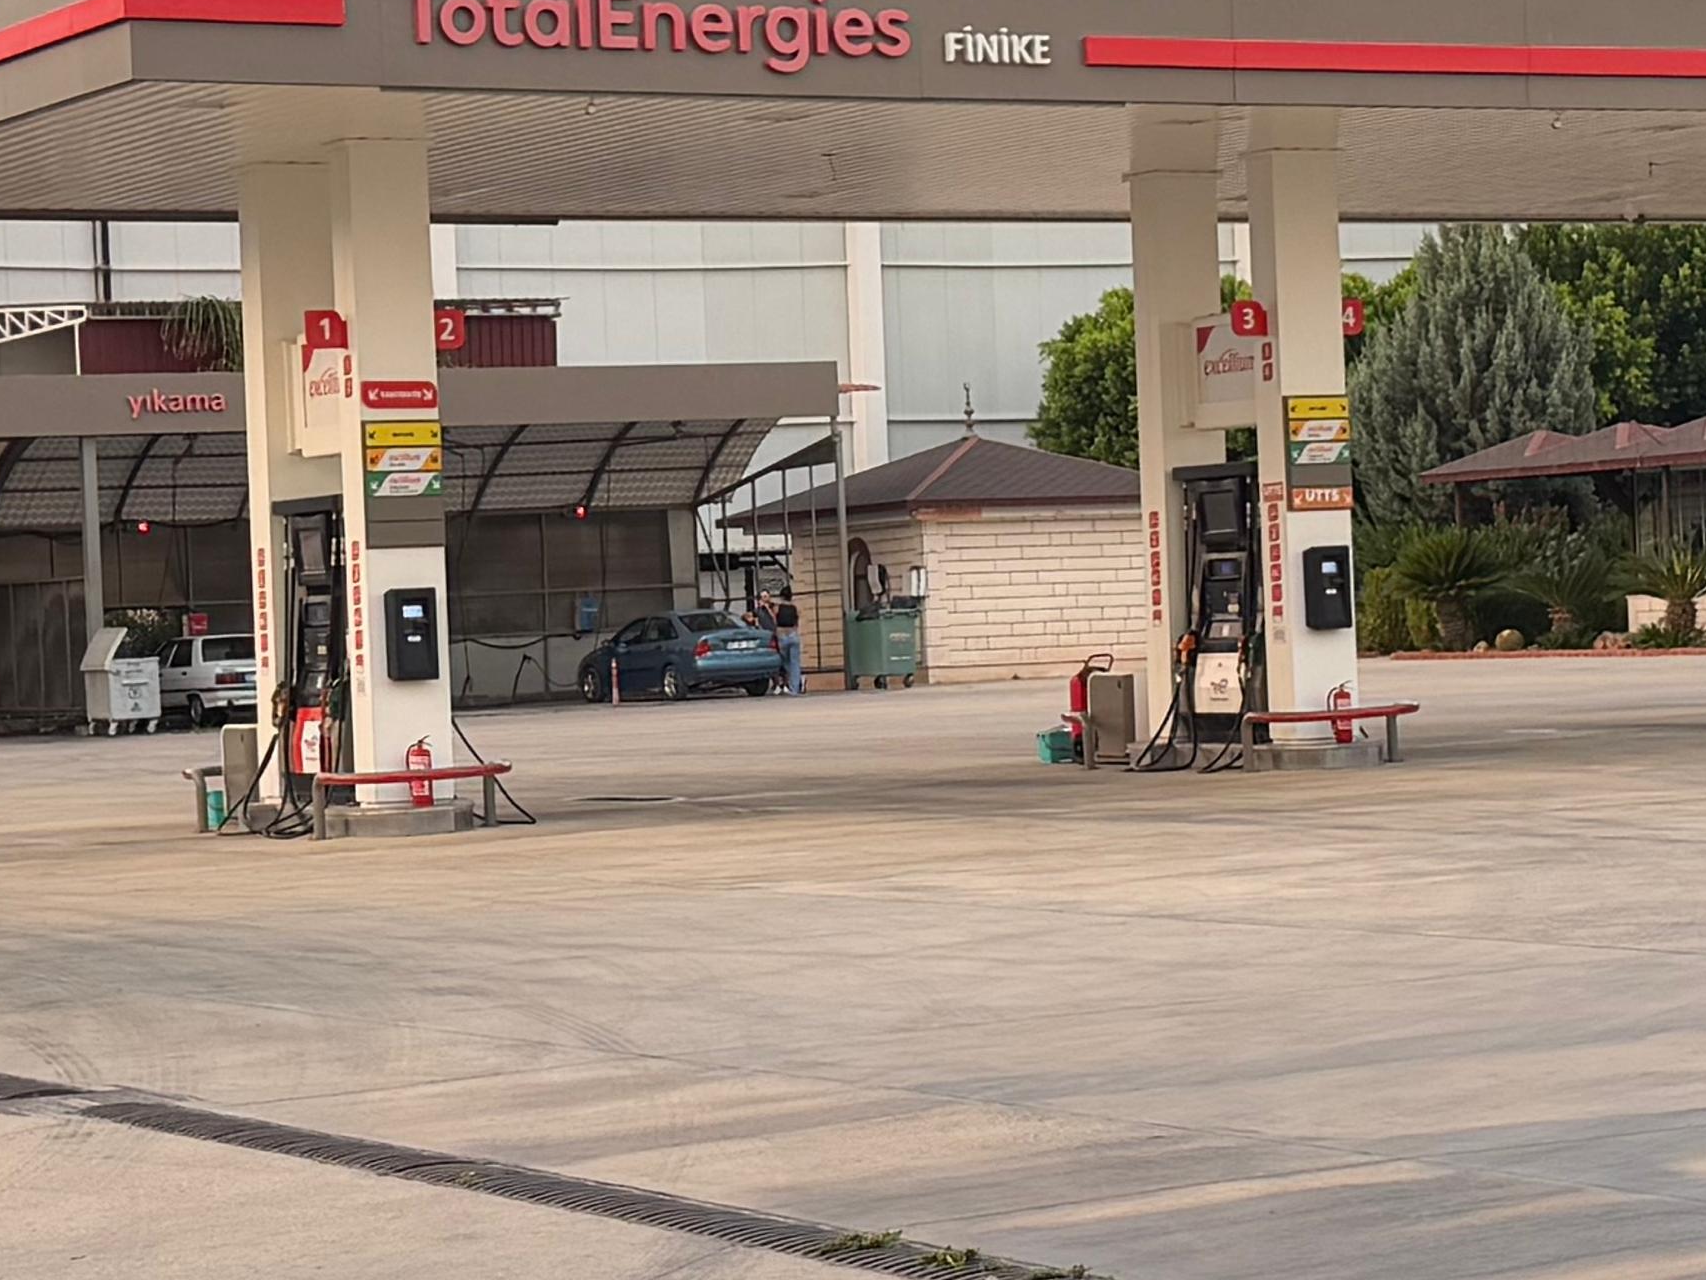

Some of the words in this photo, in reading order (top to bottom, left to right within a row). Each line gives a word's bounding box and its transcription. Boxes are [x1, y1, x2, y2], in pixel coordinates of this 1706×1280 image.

[944, 24, 1052, 64] FİNİKE
[1242, 308, 1255, 329] 3
[1342, 306, 1356, 327] 4
[319, 318, 331, 340] 1
[439, 318, 455, 341] 2
[127, 388, 227, 419] yıkama
